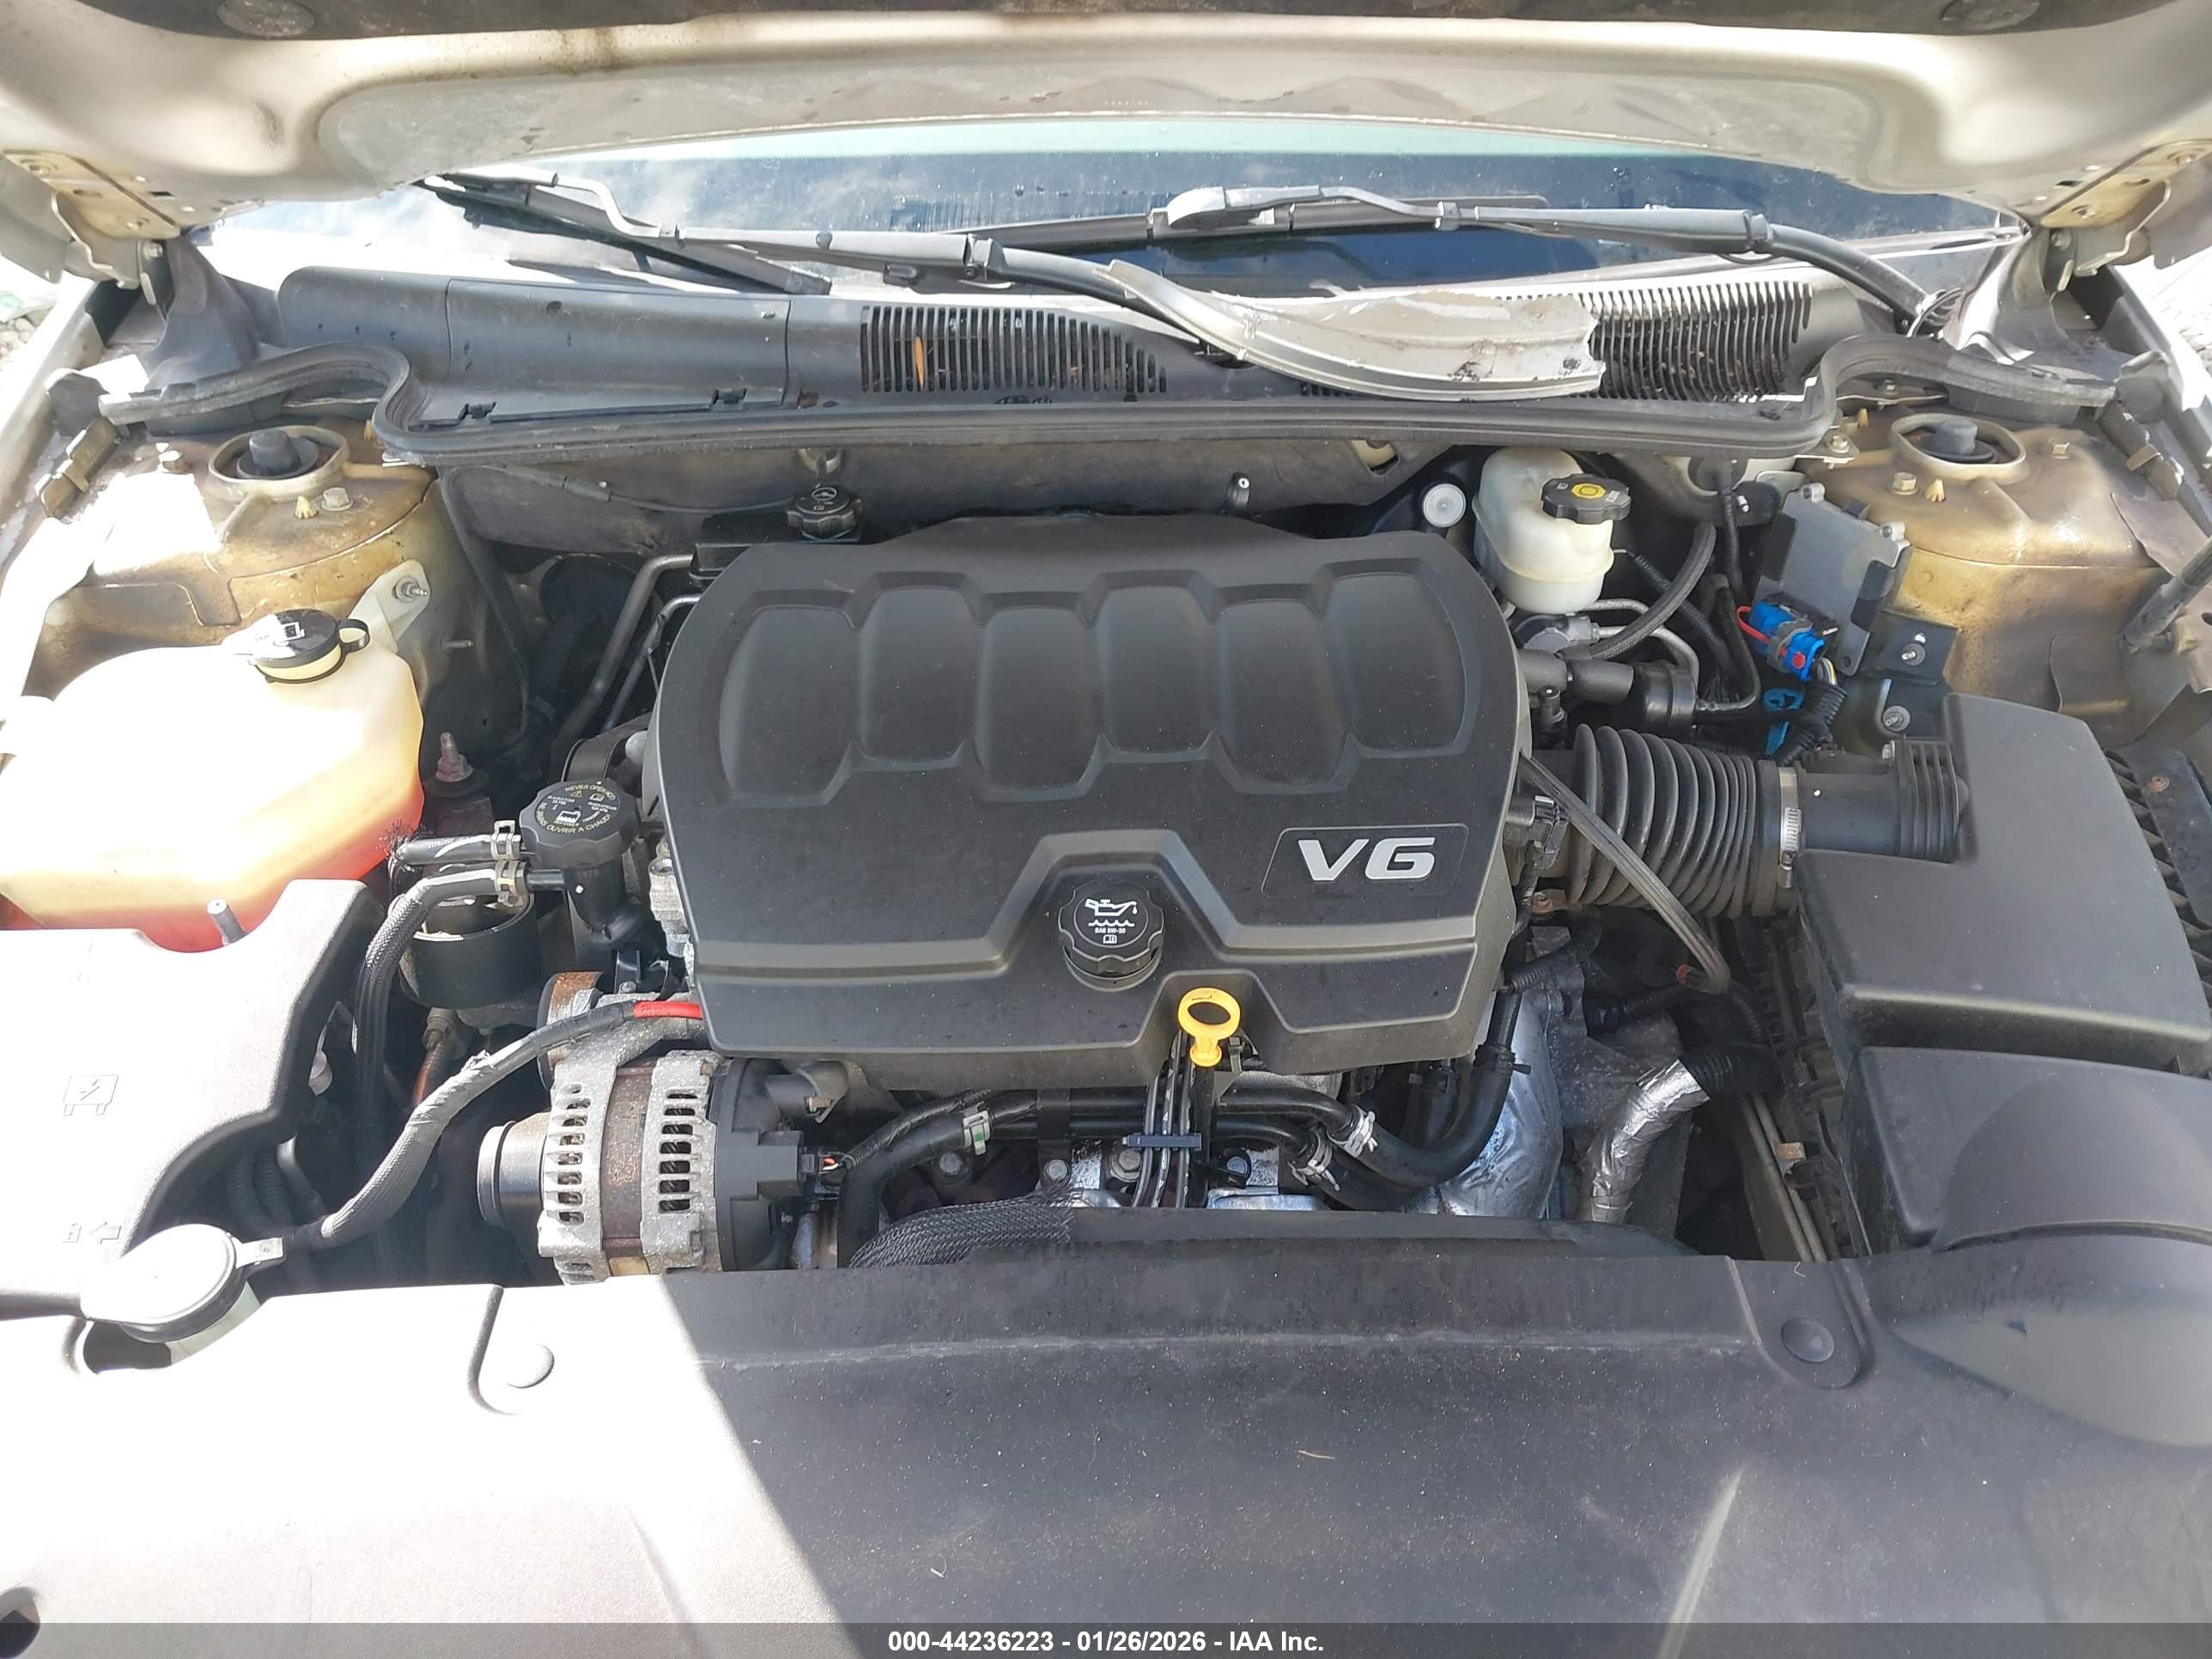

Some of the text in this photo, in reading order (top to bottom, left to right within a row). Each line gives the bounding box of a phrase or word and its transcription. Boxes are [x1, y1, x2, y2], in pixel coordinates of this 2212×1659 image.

[590, 784, 608, 793] OPEN
[546, 823, 576, 834] OUVRIR
[586, 813, 611, 830] CHAUD
[1297, 836, 1436, 881] V6
